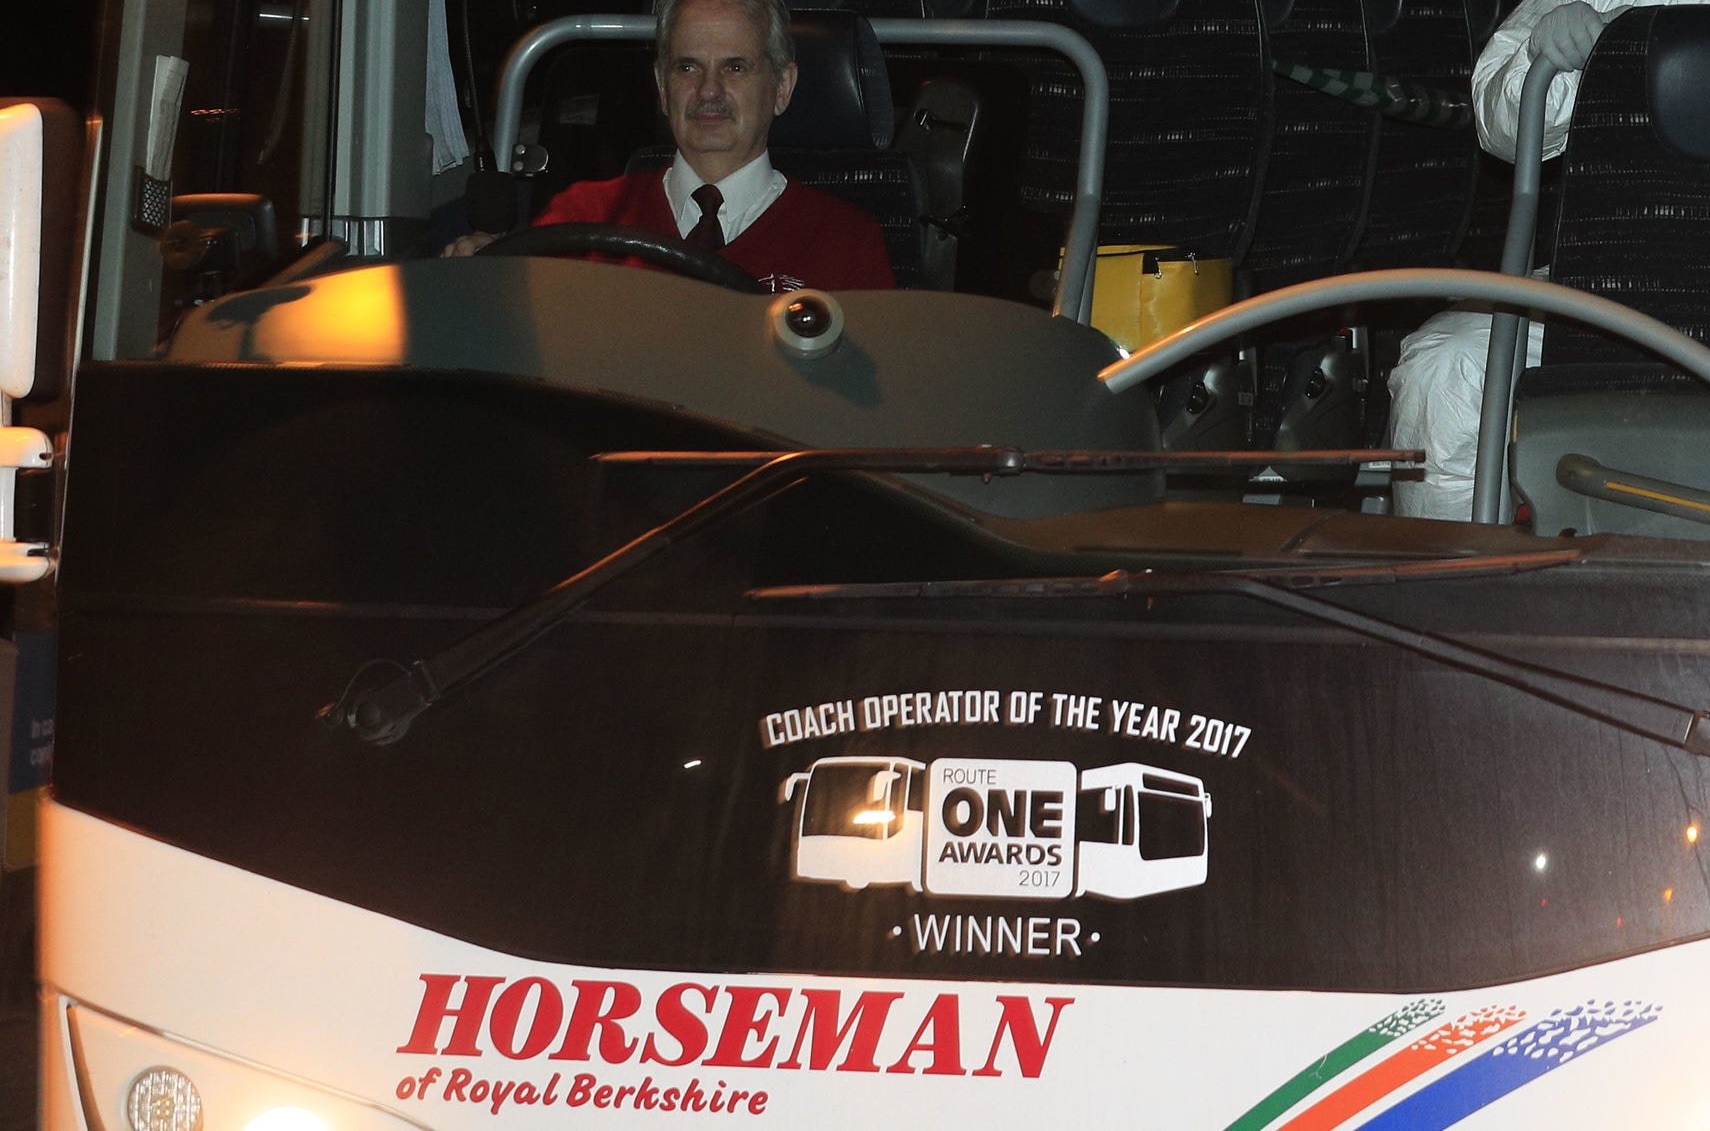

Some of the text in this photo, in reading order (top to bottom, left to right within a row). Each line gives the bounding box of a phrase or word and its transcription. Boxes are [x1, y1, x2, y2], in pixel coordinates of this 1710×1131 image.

[766, 690, 1252, 759] COACH OPERATOR OF THE YEAR 2017
[943, 767, 997, 785] ROUTE
[941, 787, 1064, 839] ONE
[938, 842, 1063, 866] AWARDS
[1018, 870, 1061, 887] 2017
[913, 914, 1082, 957] WINNER
[395, 972, 1076, 1079] HORSEMAN
[395, 1069, 769, 1116] of Royal Berkshire
